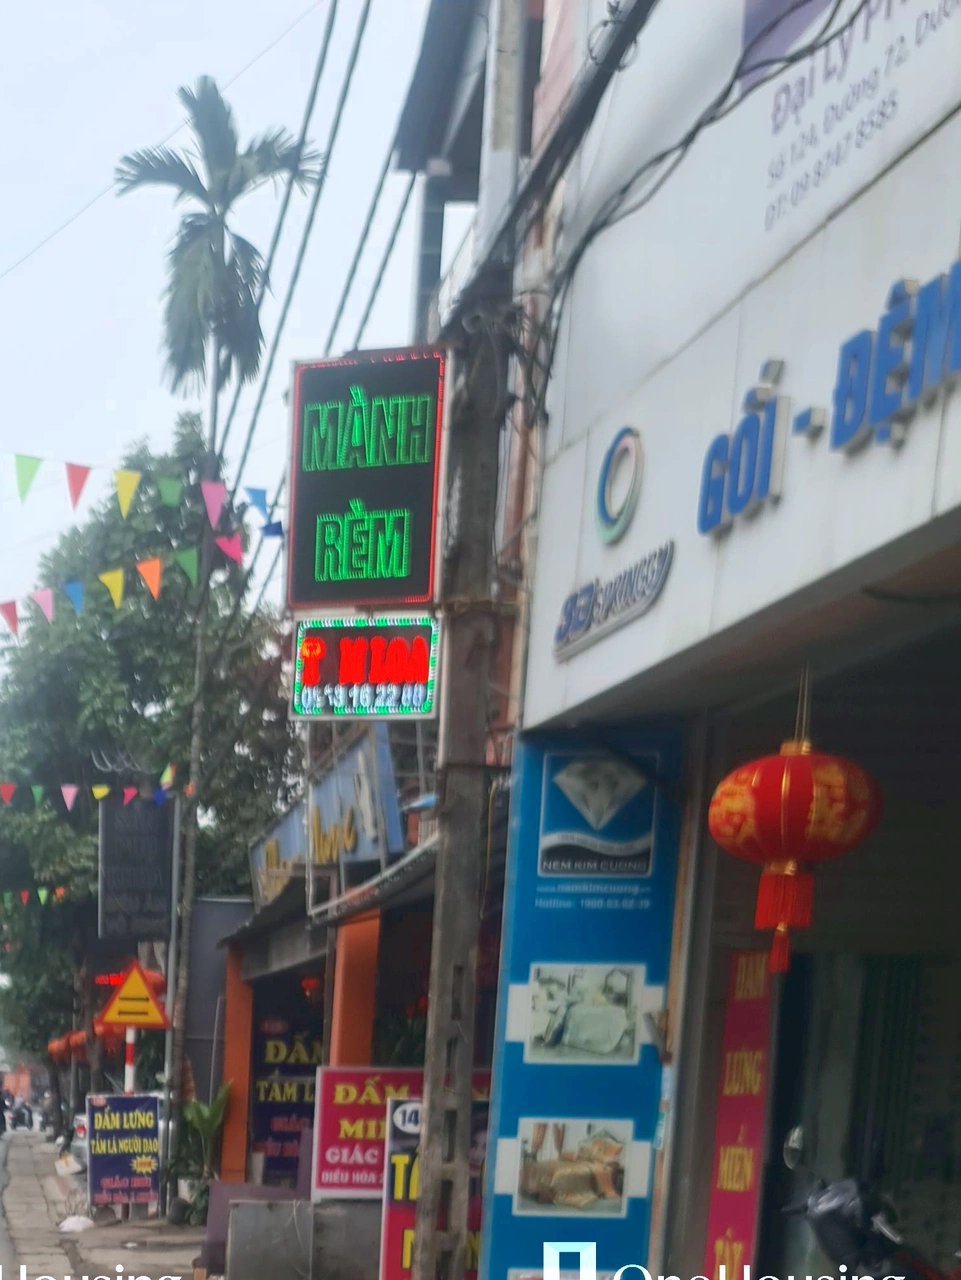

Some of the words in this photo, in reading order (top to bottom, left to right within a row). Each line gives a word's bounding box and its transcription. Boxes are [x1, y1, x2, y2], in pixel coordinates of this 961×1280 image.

[302, 384, 431, 471] MÀNH
[314, 498, 411, 581] RÈM
[325, 1144, 378, 1164] GIÁC
